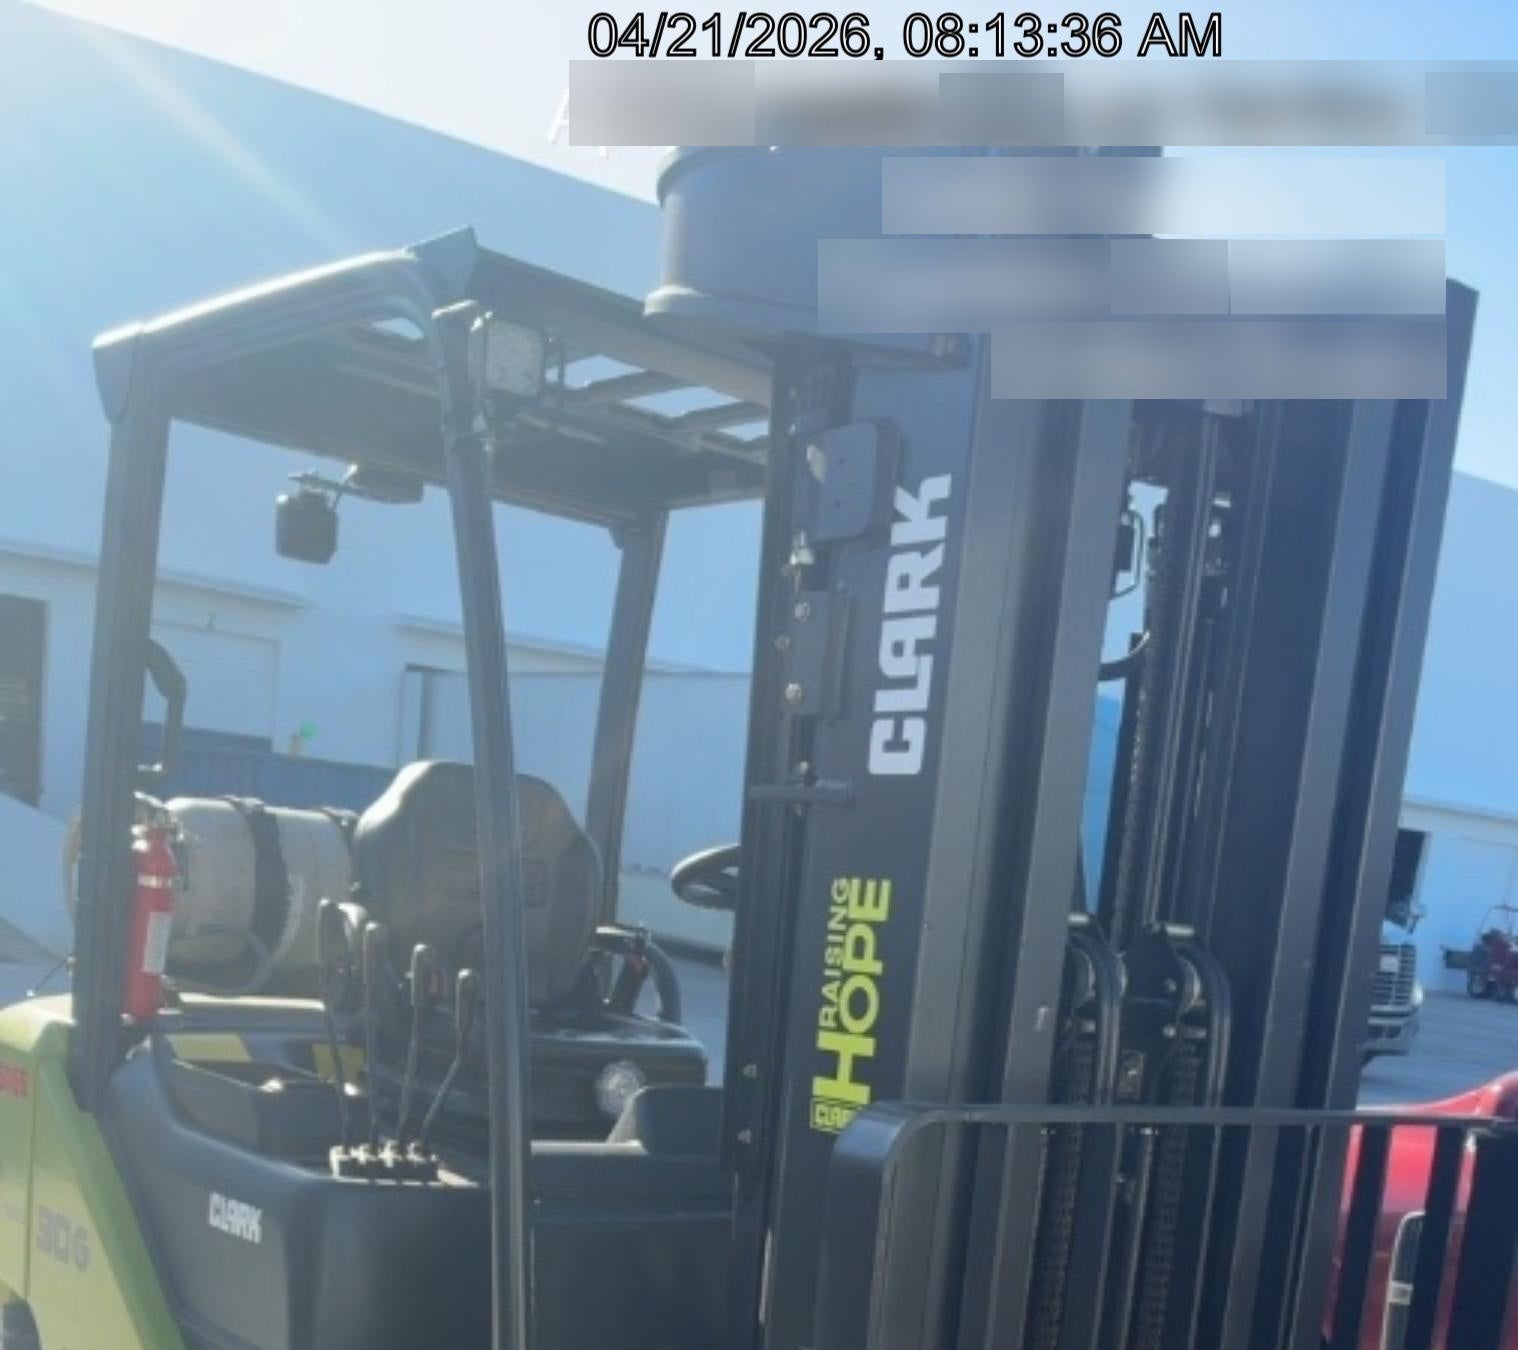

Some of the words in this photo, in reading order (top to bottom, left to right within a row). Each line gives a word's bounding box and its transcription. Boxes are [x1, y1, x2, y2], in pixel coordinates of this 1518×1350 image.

[868, 473, 952, 775] CLARK
[812, 878, 892, 1105] HOPE
[818, 878, 850, 1028] RAISING
[208, 1192, 262, 1243] CLARK
